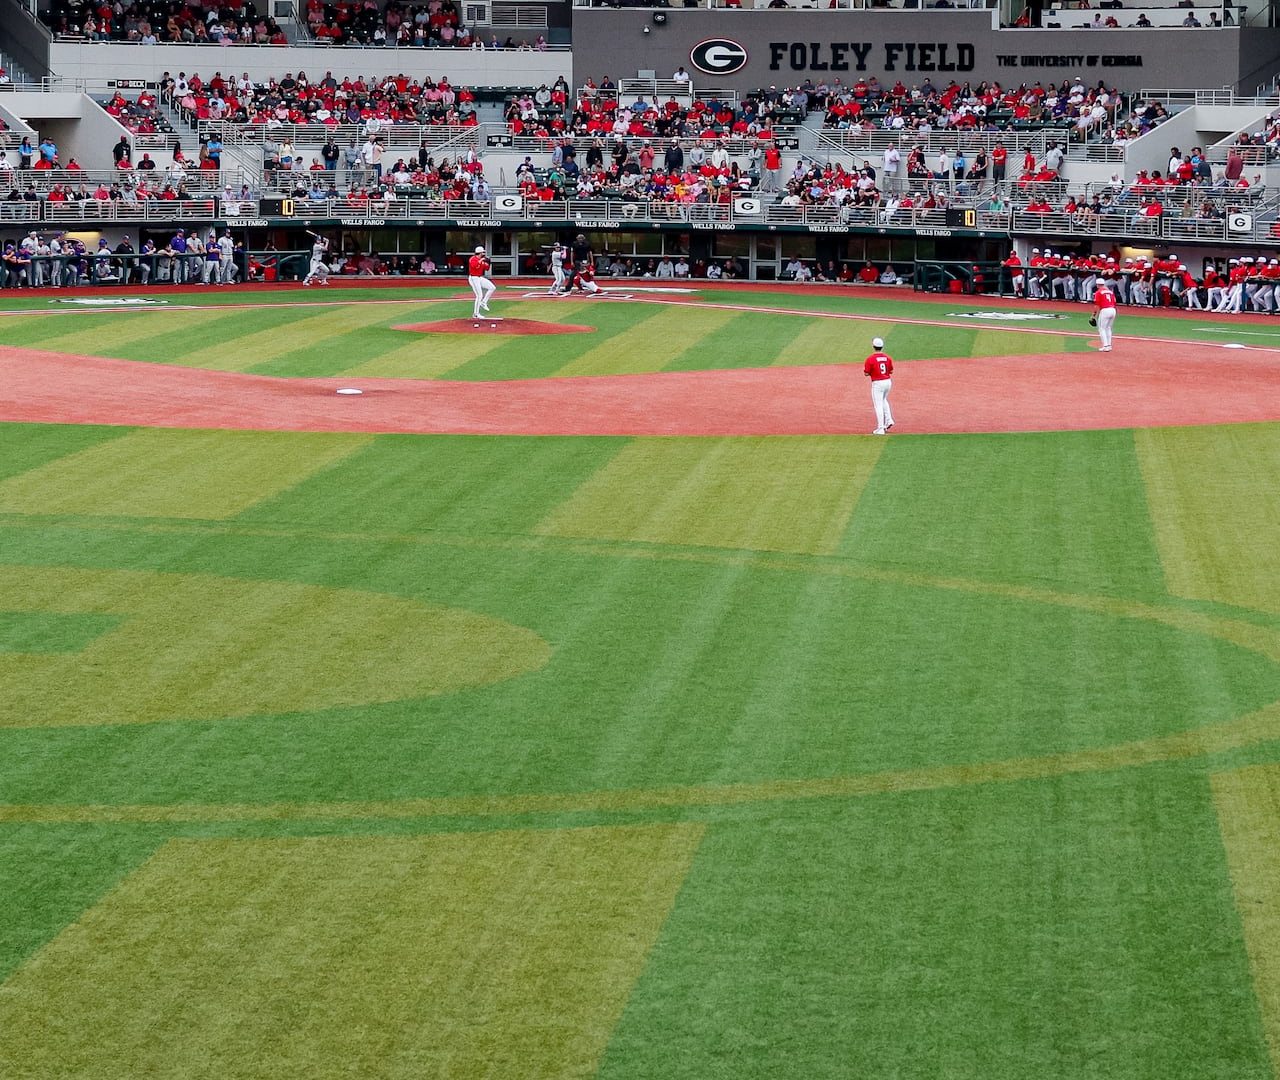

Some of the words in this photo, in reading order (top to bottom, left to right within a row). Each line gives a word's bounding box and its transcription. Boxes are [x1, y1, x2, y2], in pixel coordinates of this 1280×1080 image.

[769, 42, 872, 71] FOLEY
[884, 43, 975, 71] FIELD
[996, 55, 1018, 67] THE
[1020, 55, 1085, 67] UNIVERSITY
[1086, 55, 1100, 67] OF
[1101, 55, 1143, 67] GEORGIA
[282, 199, 295, 217] 10
[692, 221, 714, 229] WELLS
[964, 210, 976, 227] 10
